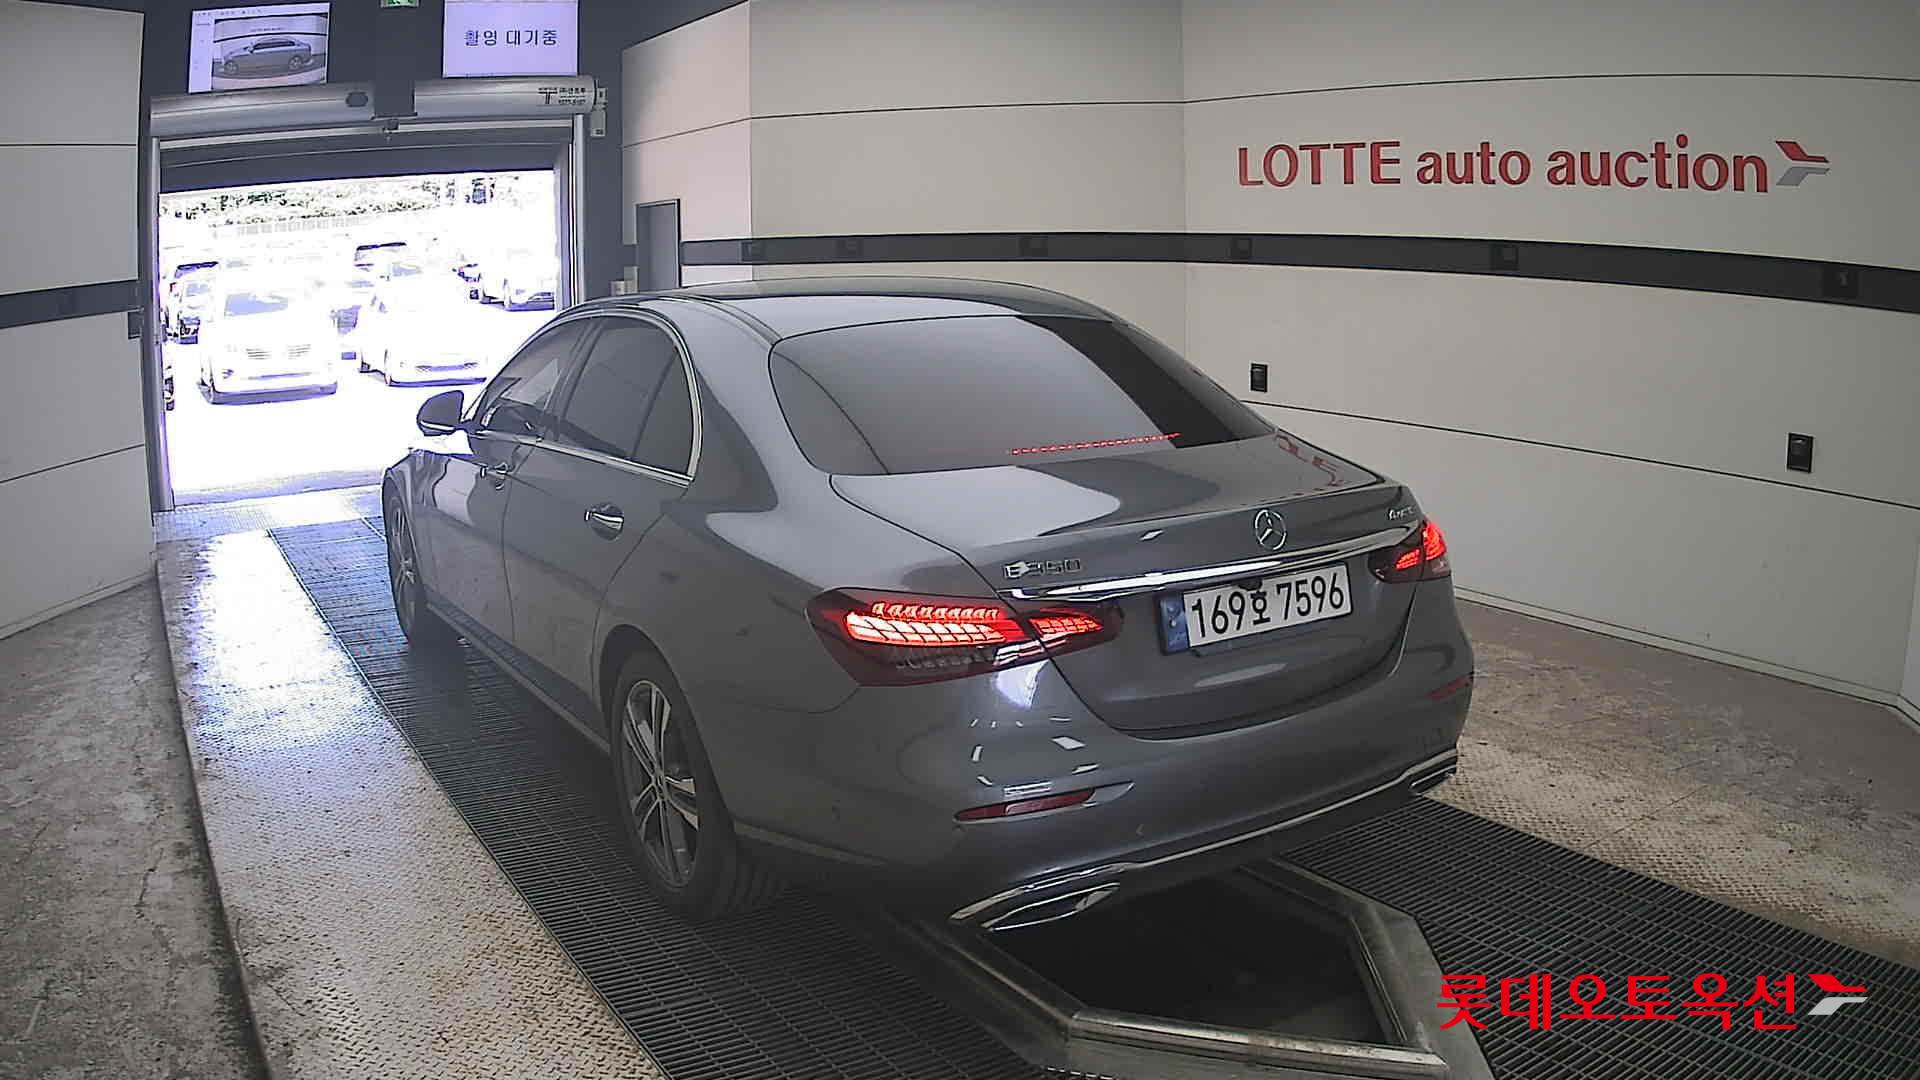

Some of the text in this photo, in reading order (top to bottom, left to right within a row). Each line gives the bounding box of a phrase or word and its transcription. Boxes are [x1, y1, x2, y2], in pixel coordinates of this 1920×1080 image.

[506, 30, 557, 46] 대기중
[1238, 134, 1768, 193] LOTTE auto auction
[1191, 572, 1345, 638] 169호 7596
